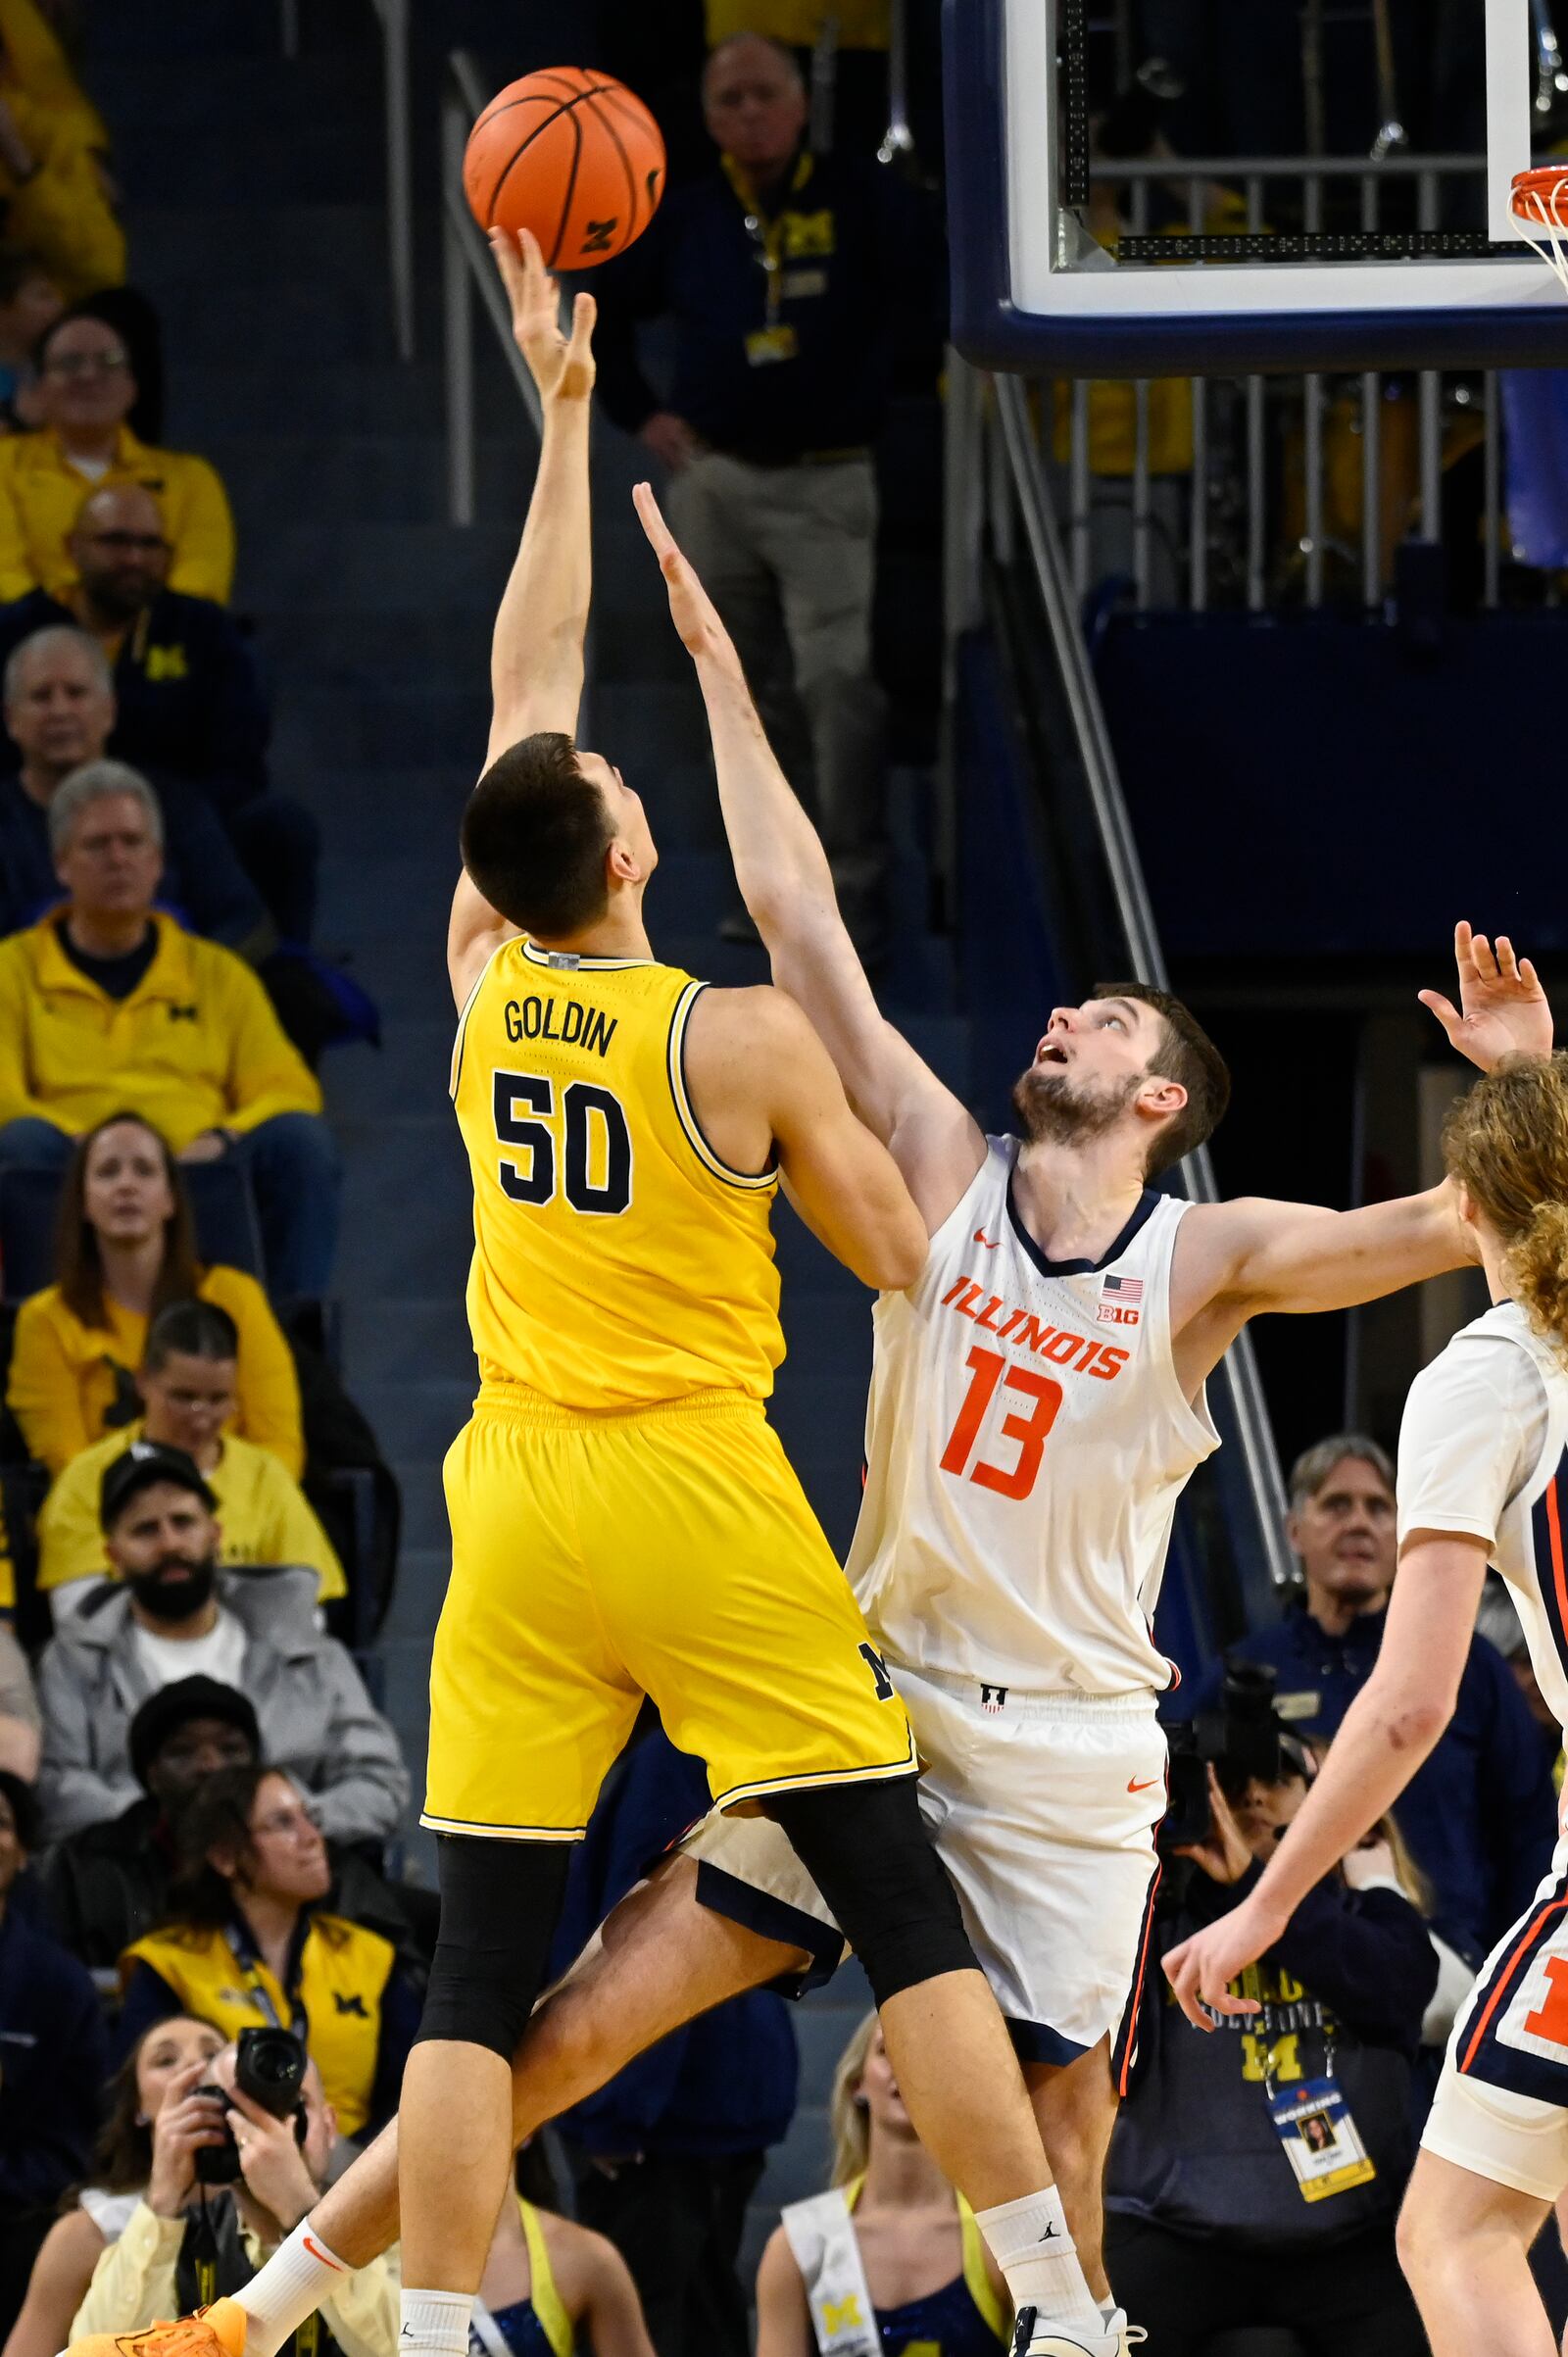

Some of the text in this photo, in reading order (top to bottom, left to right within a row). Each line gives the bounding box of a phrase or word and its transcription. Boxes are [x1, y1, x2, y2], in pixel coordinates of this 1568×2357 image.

[504, 996, 618, 1058] GOLDIN
[493, 1068, 631, 1215] 50
[940, 1275, 1130, 1381] ILLINOIS
[939, 1345, 1063, 1501] 13
